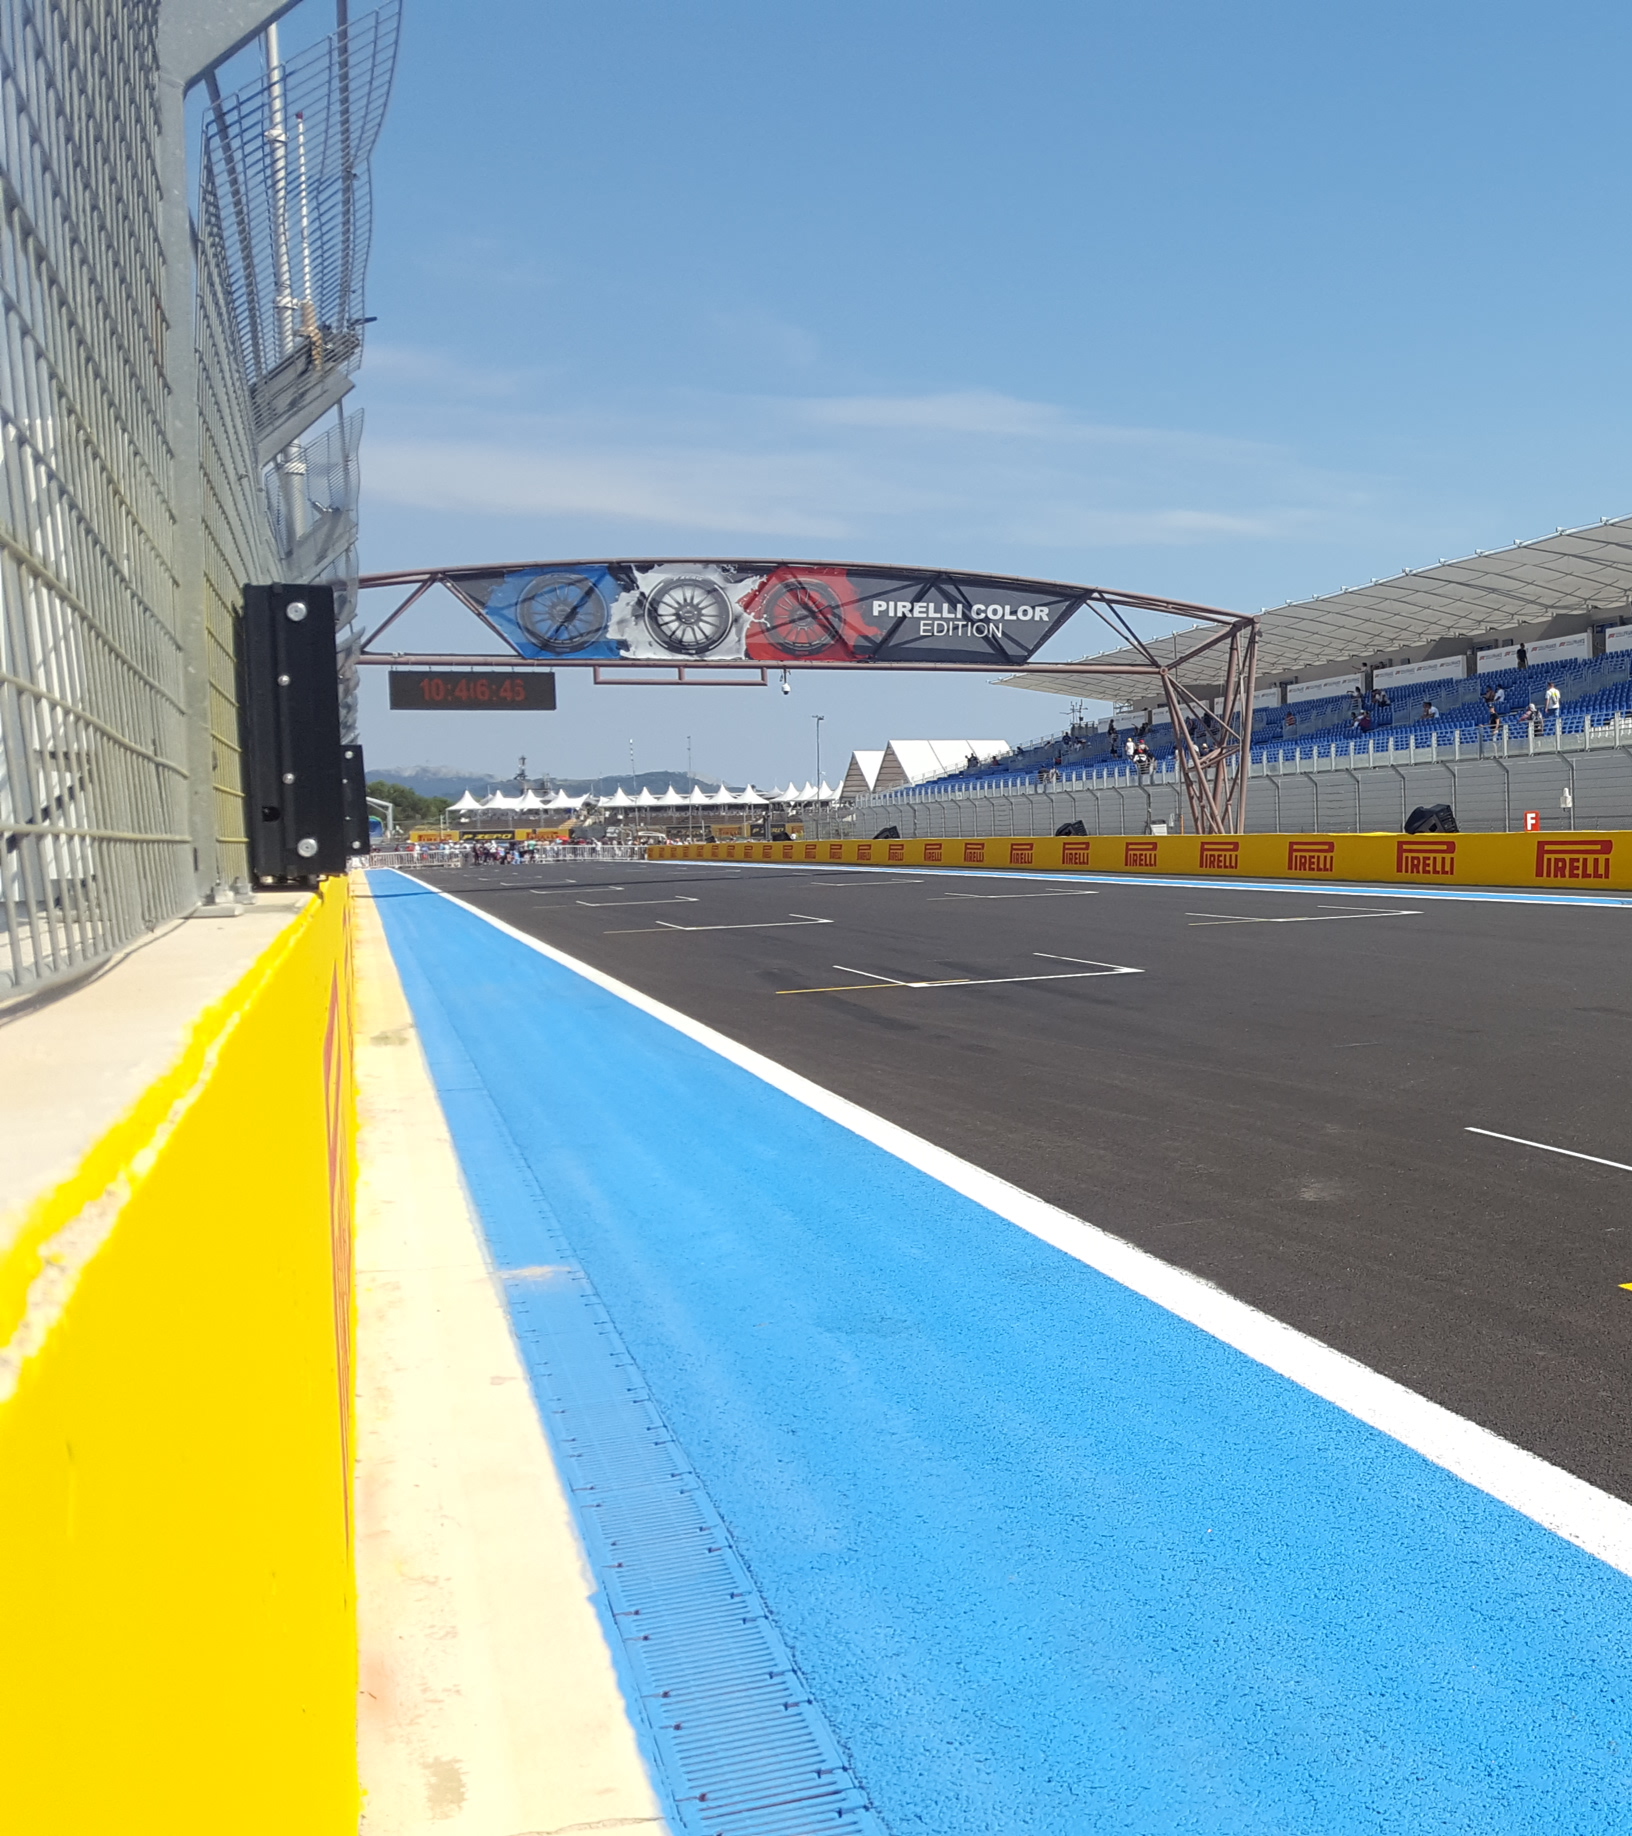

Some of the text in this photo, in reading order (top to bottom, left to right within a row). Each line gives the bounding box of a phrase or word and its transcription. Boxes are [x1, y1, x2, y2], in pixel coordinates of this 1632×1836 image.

[872, 600, 1049, 621] PIRELLI COLOR
[919, 620, 1002, 638] EDITION
[1526, 813, 1536, 831] F
[964, 843, 985, 863] PIRELLI
[1010, 843, 1034, 865] PIRELLI
[1062, 842, 1090, 866] PIRELLI
[1125, 842, 1157, 868] PIRELLI
[1200, 841, 1239, 870] PIRELLI
[1287, 841, 1335, 872] PIRELLI
[1397, 841, 1456, 876] PIRELLI
[1535, 840, 1613, 879] PIRELLI
